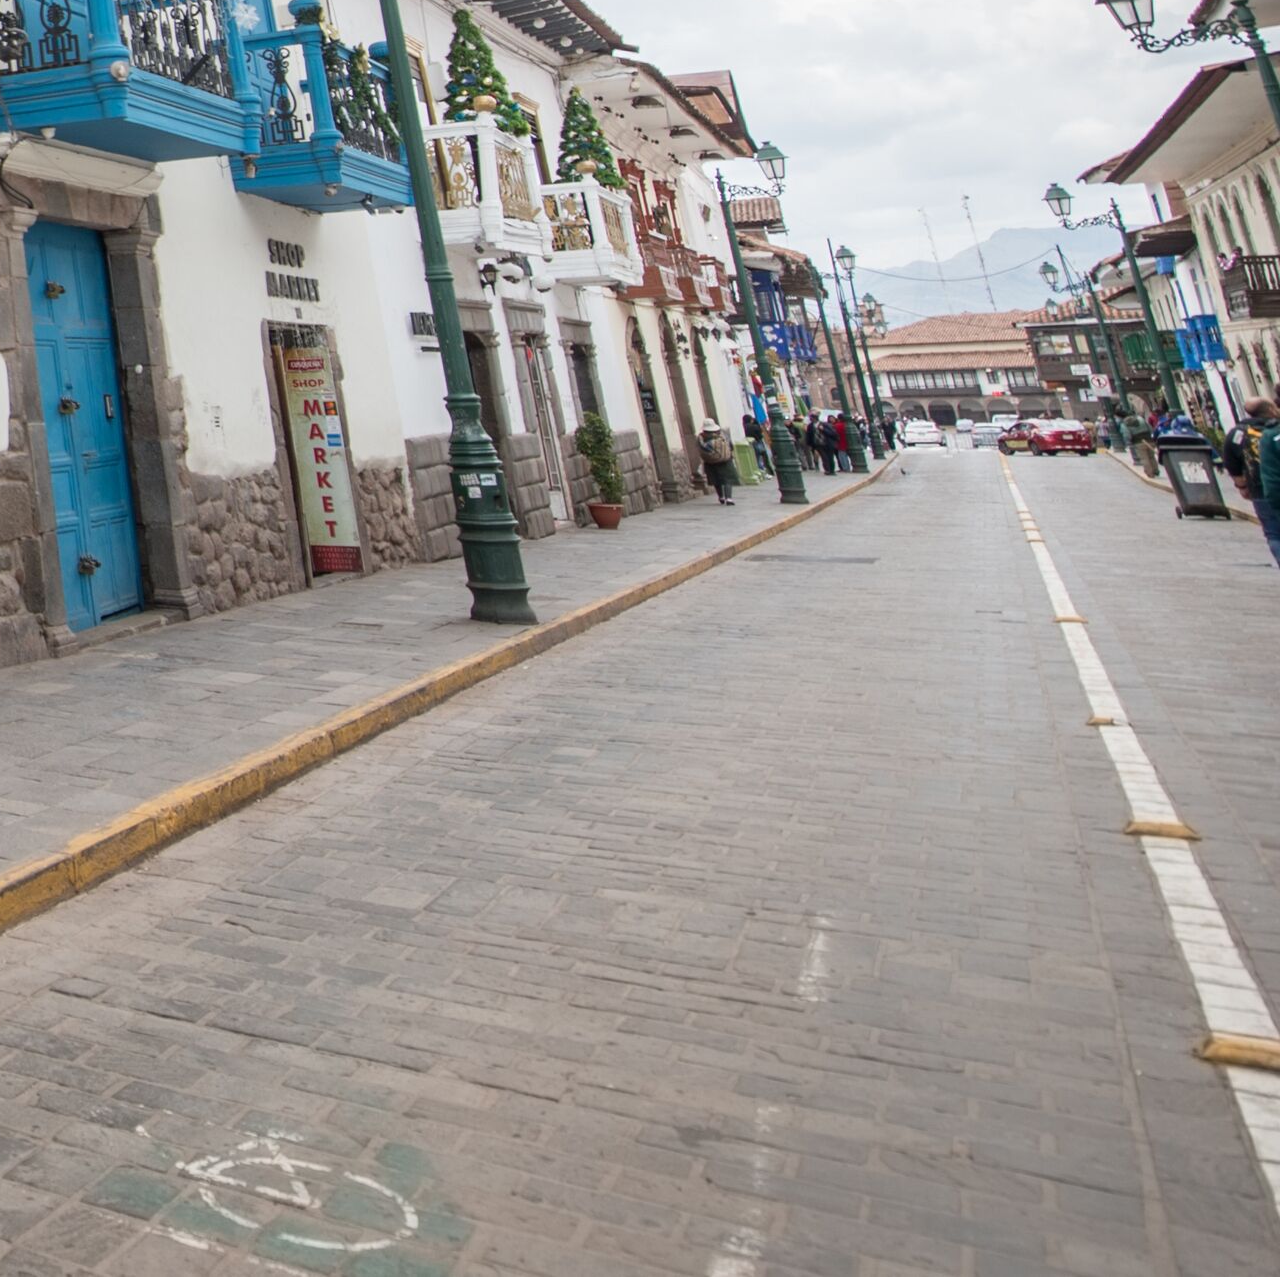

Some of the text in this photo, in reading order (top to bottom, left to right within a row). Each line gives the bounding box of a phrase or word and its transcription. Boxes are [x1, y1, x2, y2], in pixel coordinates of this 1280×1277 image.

[267, 238, 305, 268] SHOP
[265, 271, 320, 302] MARKET
[292, 379, 325, 388] SHOP
[303, 398, 337, 538] MARKET
